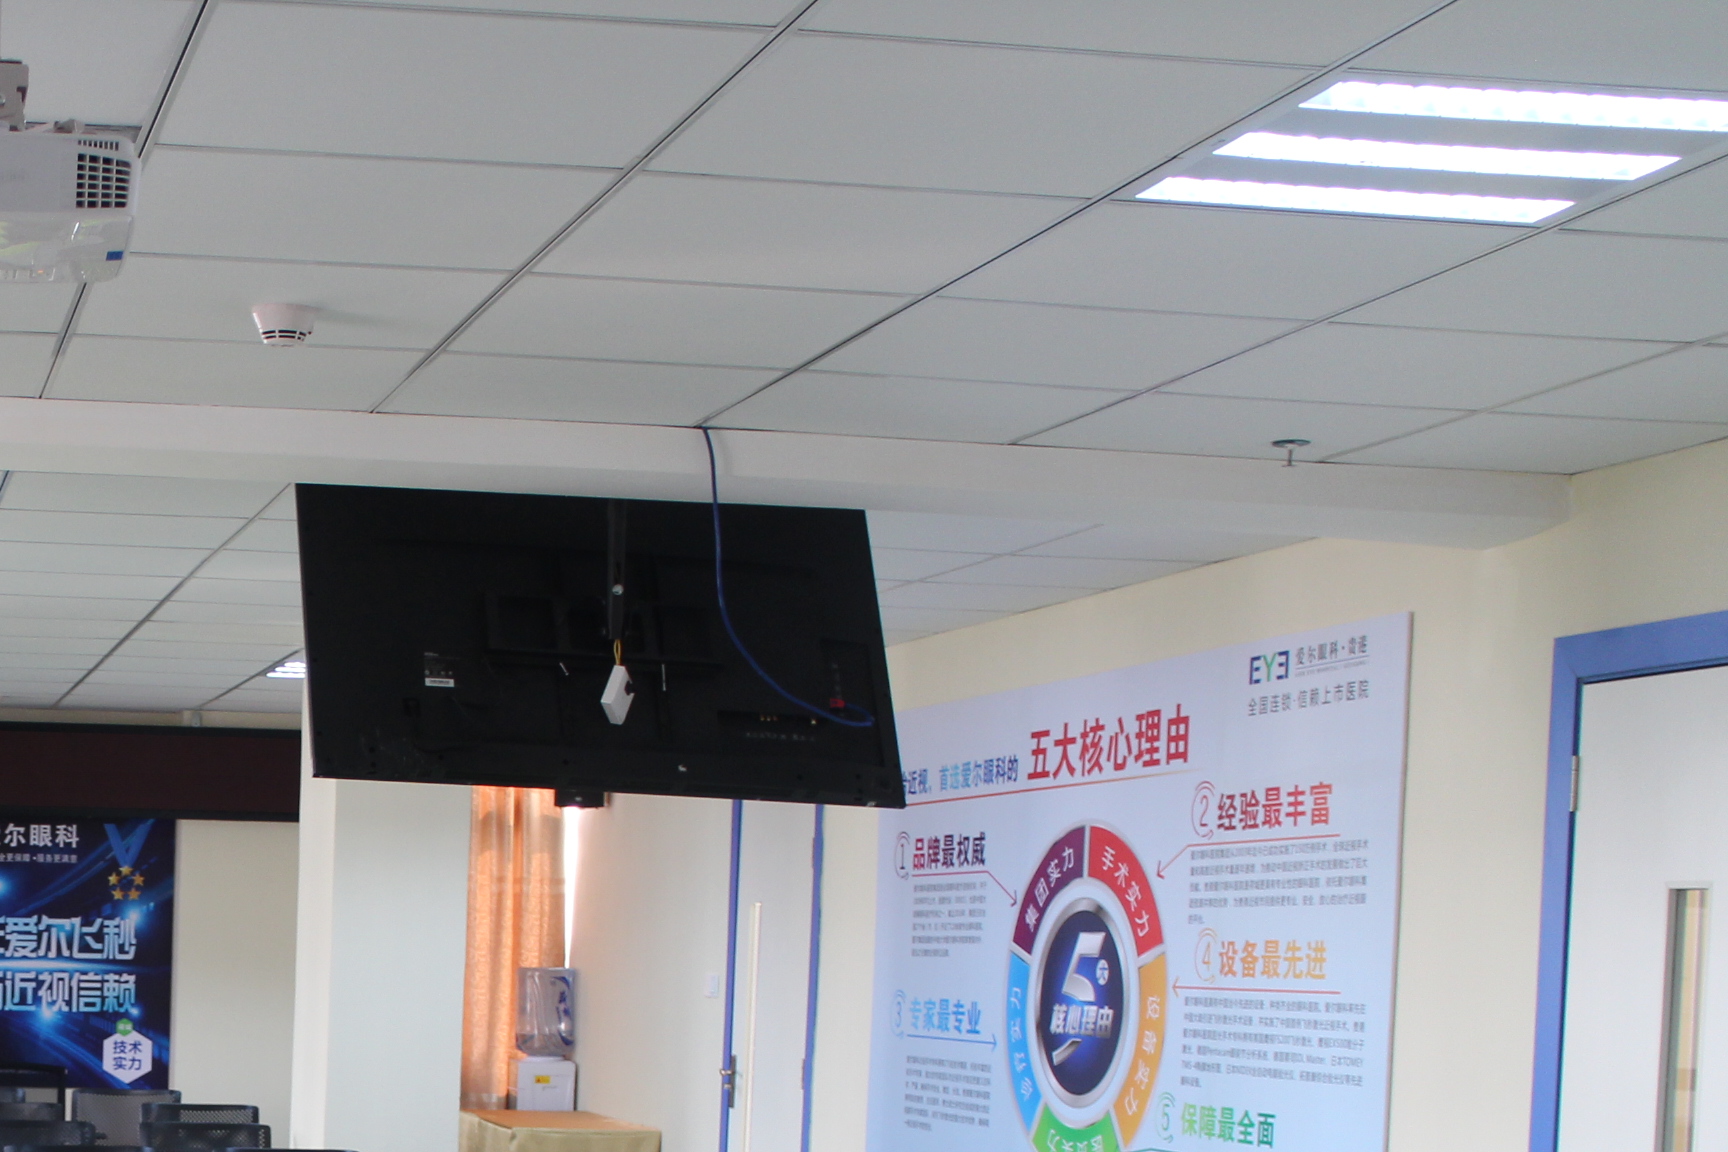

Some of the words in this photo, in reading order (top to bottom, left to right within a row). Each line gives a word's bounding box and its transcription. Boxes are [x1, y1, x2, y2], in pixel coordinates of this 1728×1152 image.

[1027, 703, 1190, 780] 五大核心理由
[1217, 781, 1332, 831] 经验最丰富
[913, 832, 986, 870] 品牌最权威
[1025, 846, 1075, 932] 集团实力
[1101, 846, 1149, 937] 手术实力
[1219, 939, 1327, 980] 设备最先进
[910, 998, 981, 1034] 专家最专业
[1050, 1003, 1114, 1038] 核心理由
[113, 1040, 142, 1054] 技术
[113, 1056, 142, 1070] 实力
[1125, 995, 1161, 1116] 设备实力
[1181, 1102, 1276, 1149] 保障最全面
